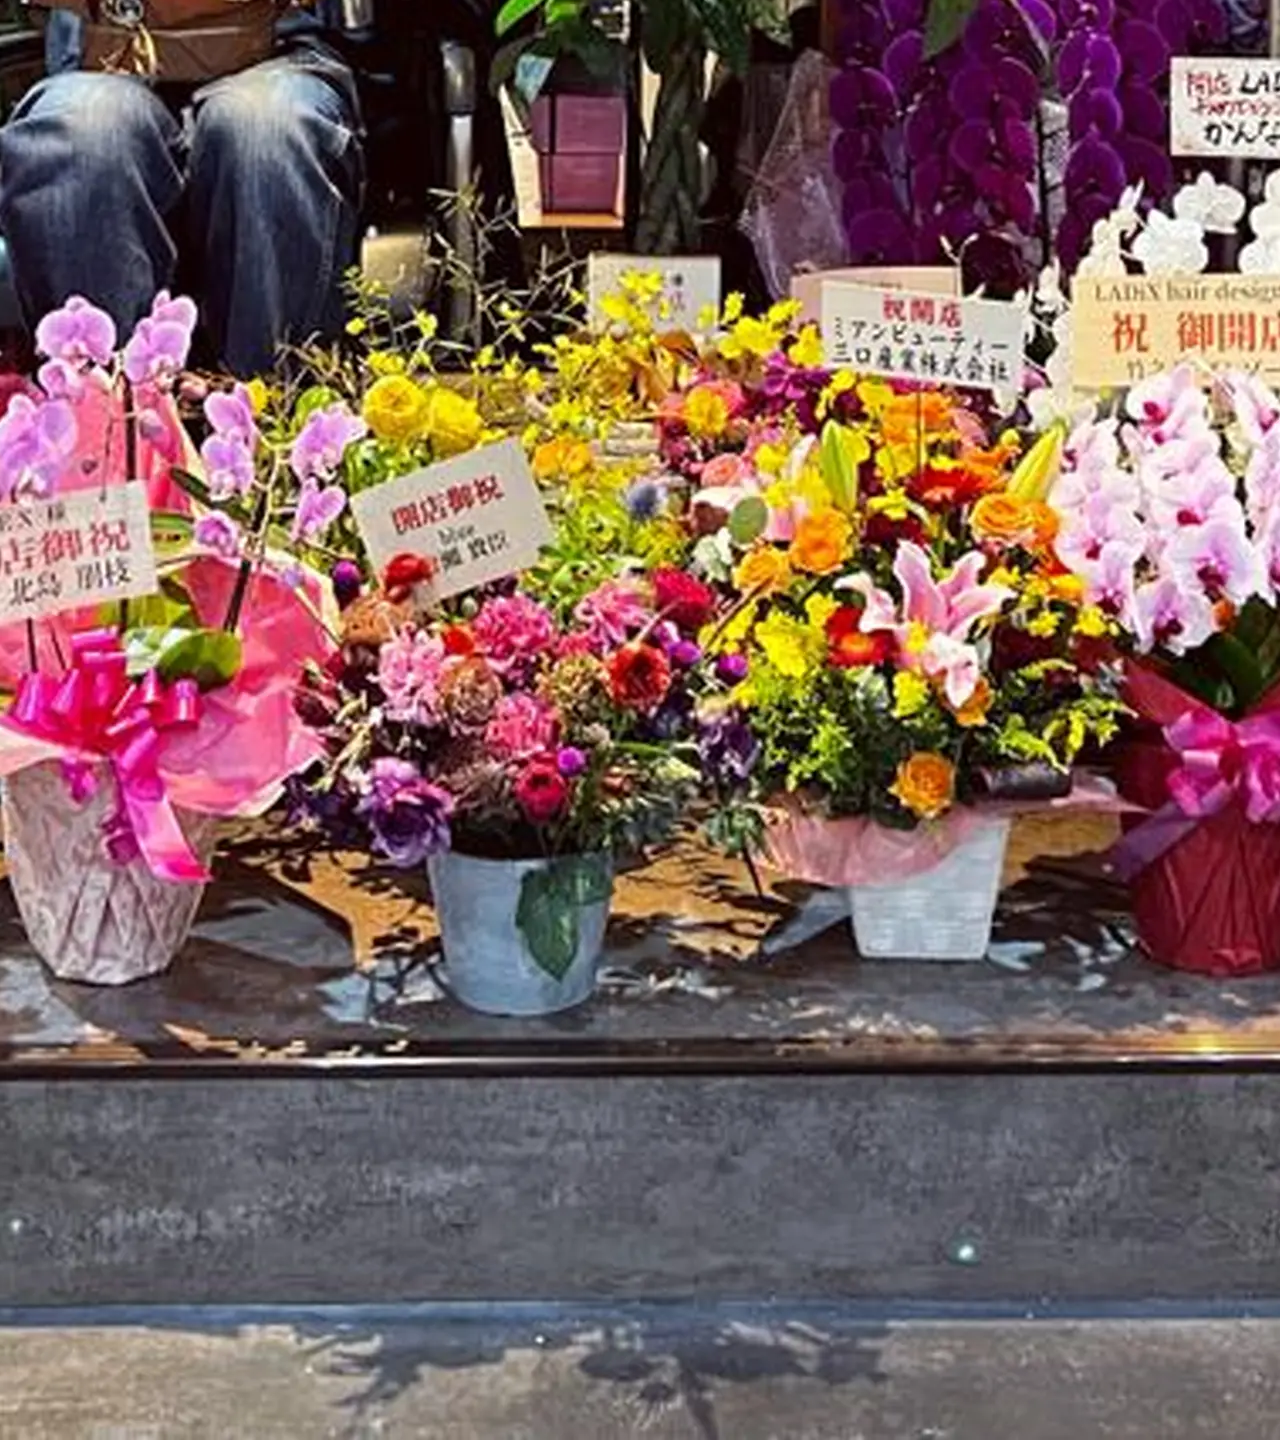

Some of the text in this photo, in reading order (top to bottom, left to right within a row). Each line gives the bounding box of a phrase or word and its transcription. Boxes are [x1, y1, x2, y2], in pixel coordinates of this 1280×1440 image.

[883, 294, 963, 329] 祝開店
[1112, 311, 1150, 353] 祝
[392, 474, 505, 535] 開店御祝
